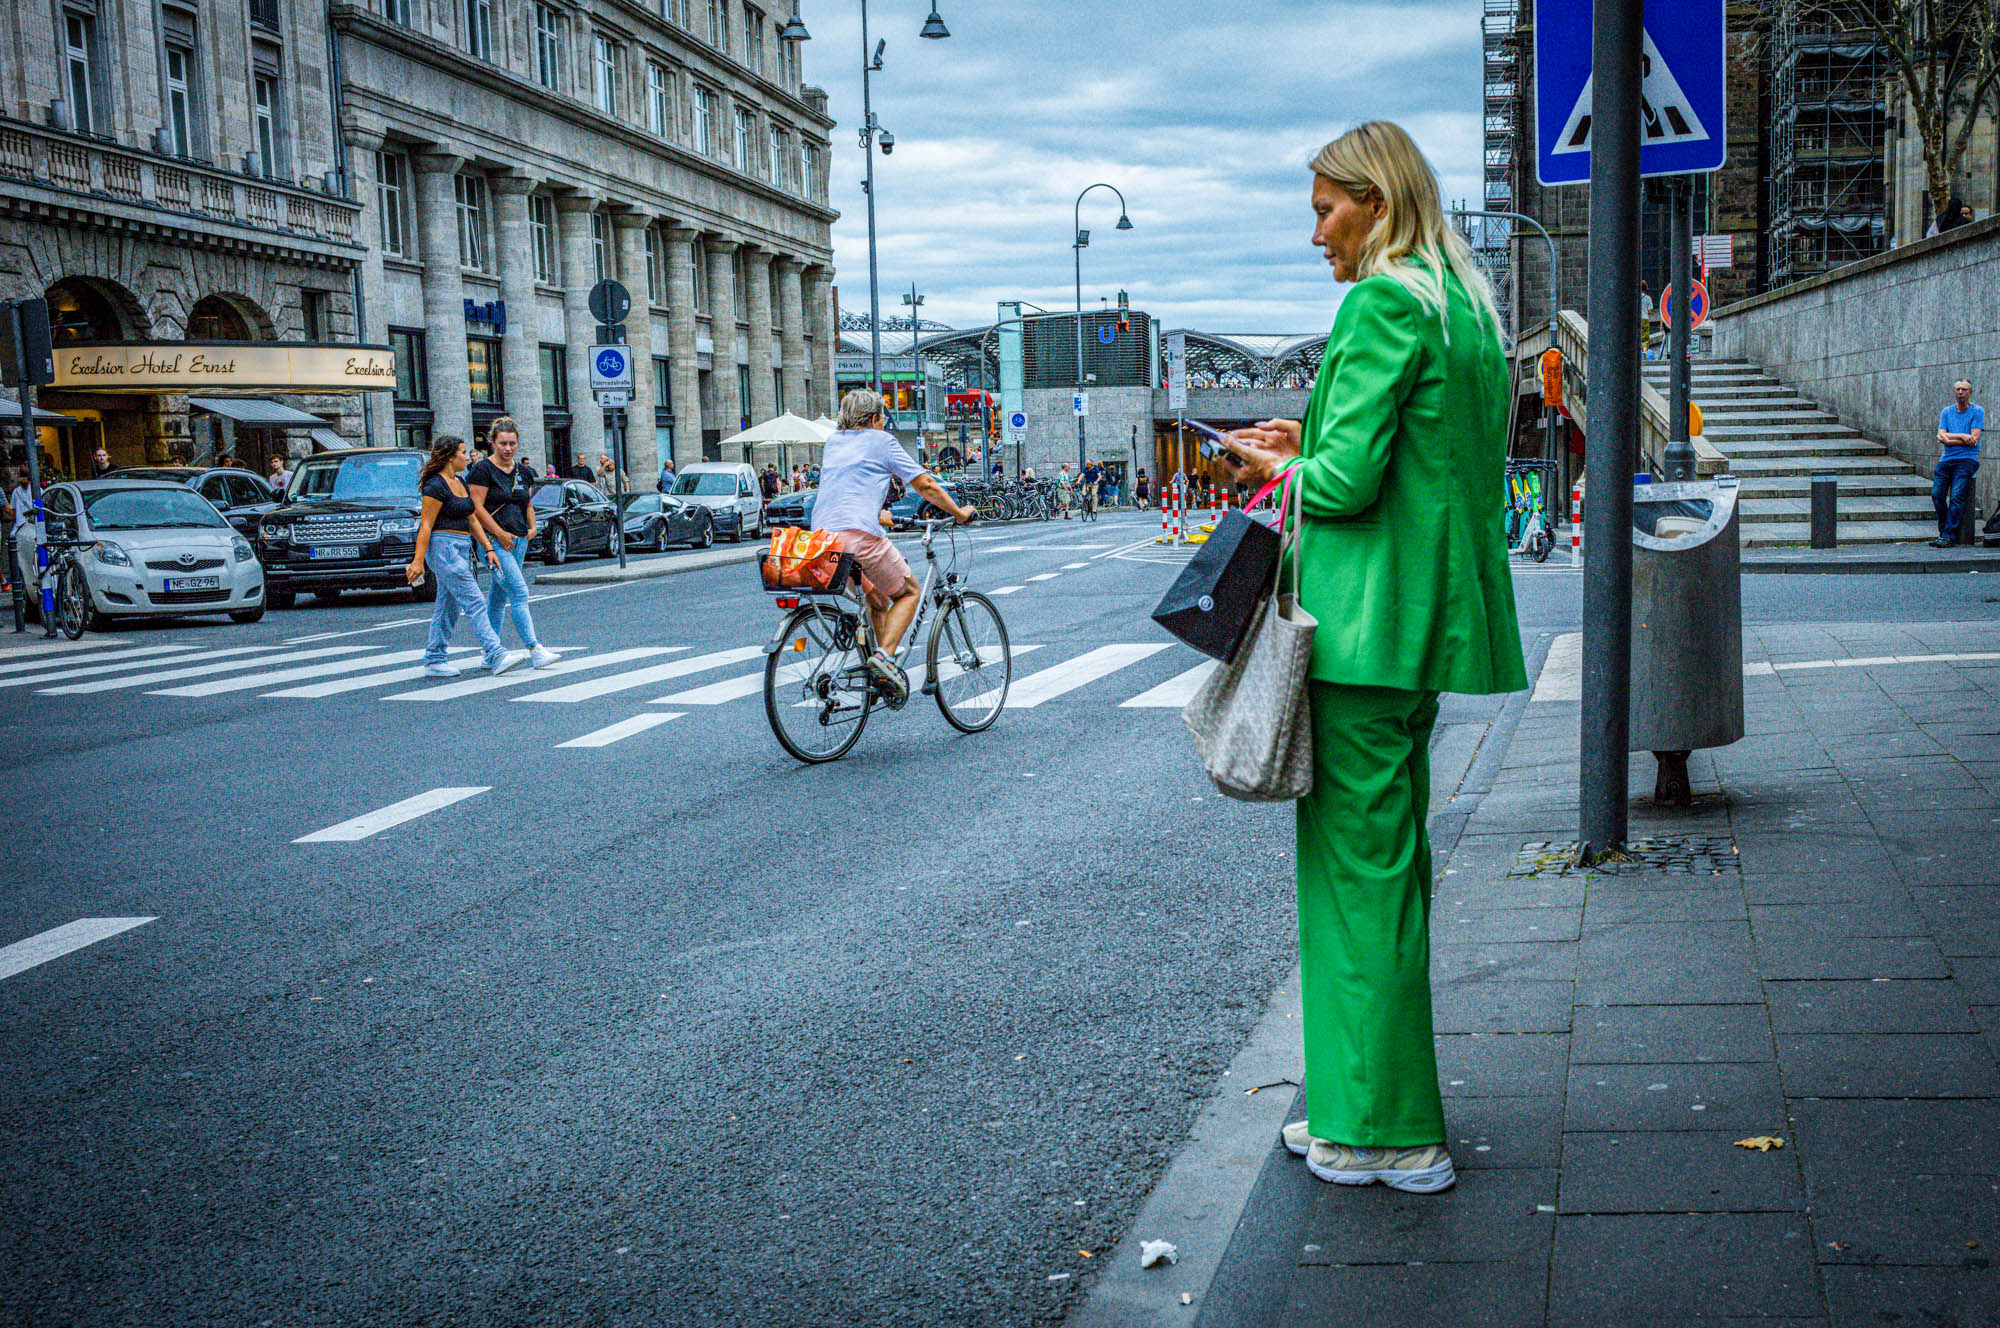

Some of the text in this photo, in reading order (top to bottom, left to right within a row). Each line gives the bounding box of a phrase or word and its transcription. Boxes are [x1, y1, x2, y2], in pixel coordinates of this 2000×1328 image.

[1098, 326, 1114, 344] U
[70, 351, 236, 375] Excelsior Hotel Ernst
[337, 513, 375, 521] ROVER
[315, 547, 358, 557] NR RR 555
[172, 577, 215, 588] NE GZ 96
[909, 595, 928, 647] GIANT
